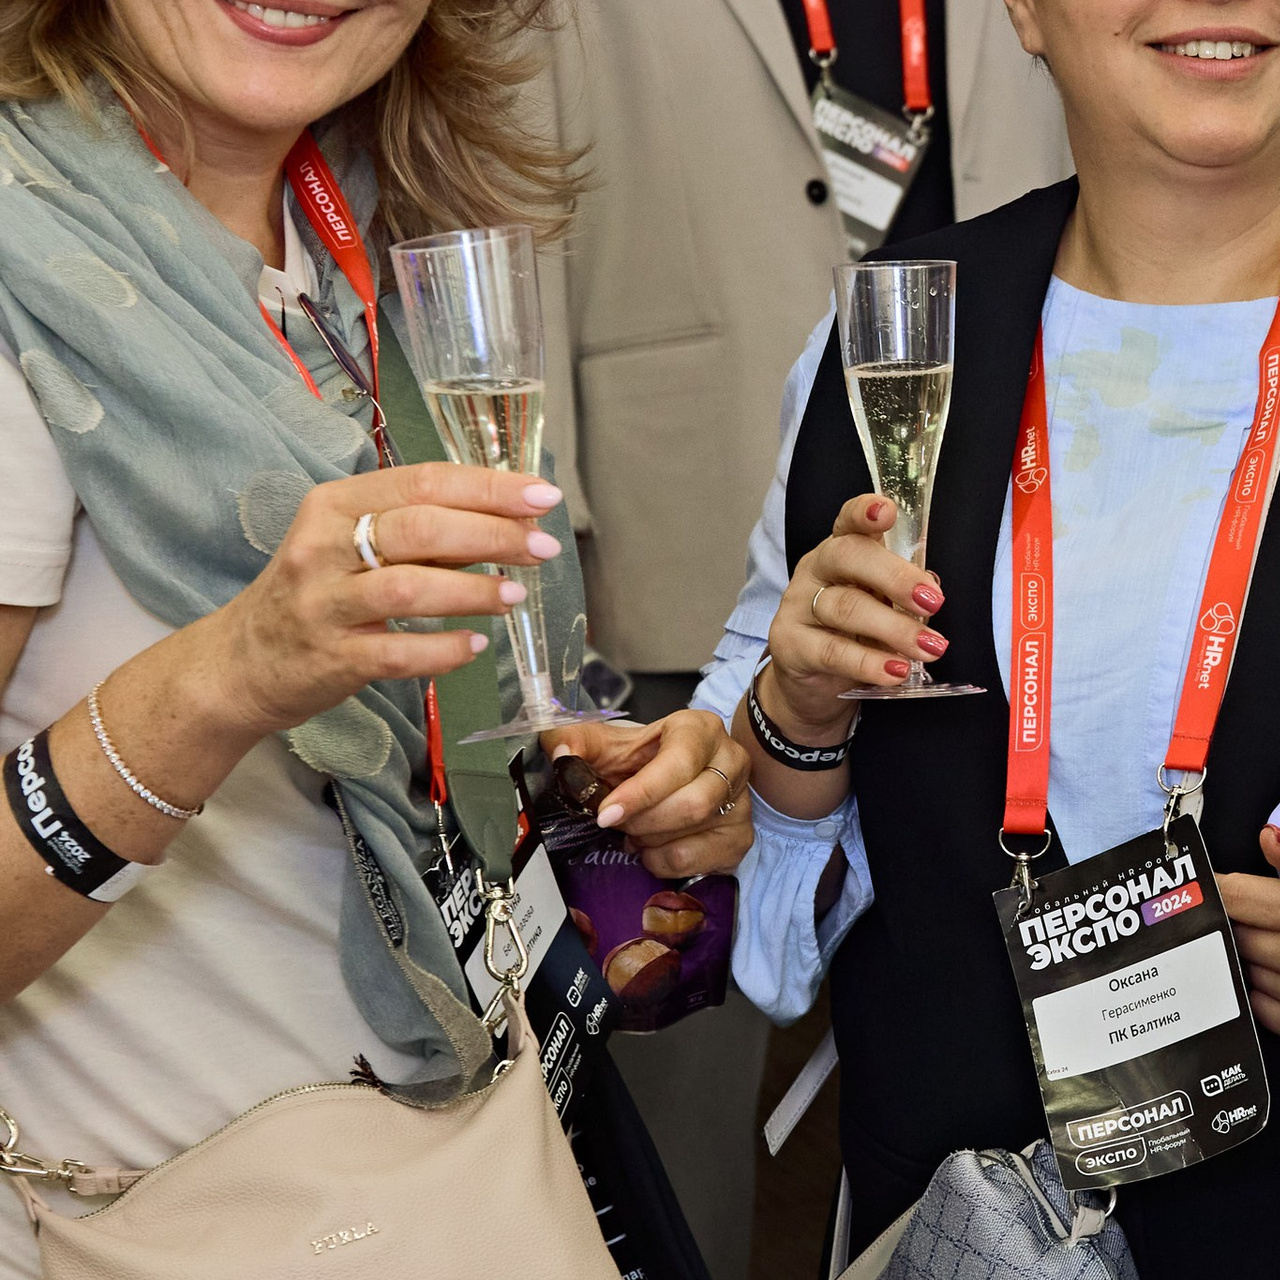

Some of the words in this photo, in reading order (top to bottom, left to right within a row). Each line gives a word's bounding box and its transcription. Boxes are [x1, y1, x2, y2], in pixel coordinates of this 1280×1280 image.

[300, 160, 352, 241] ПЕРСОНАЛ
[1255, 353, 1280, 441] ПЕРСОНАЛ
[1021, 426, 1036, 470] HRnet
[1242, 456, 1258, 496] ЭКСПО
[1235, 505, 1250, 550] Глобальный
[1027, 580, 1038, 622] ЭКСПО
[1198, 635, 1226, 689] HRnet
[1022, 641, 1039, 743] ПЕРСОНАЛ
[58, 830, 92, 863] 2024
[1018, 853, 1198, 948] ПЕРСОНАЛ
[1034, 879, 1109, 915] обальный
[1026, 908, 1141, 971] ЭКСПО
[1151, 889, 1193, 919] 2024
[1108, 966, 1160, 993] Оксана
[1101, 986, 1177, 1021] Герасименко
[1109, 1027, 1129, 1045] ПК
[1130, 1011, 1182, 1038] Балтика
[542, 1019, 570, 1081] РСОНАЛ
[1221, 1063, 1243, 1080] КАК
[1223, 1072, 1247, 1087] ДЕЛАТЬ
[553, 1080, 568, 1110] КСПО
[1077, 1097, 1185, 1142] ПЕРСОНАЛ
[1230, 1105, 1257, 1123] HRnet
[1148, 1128, 1191, 1148] Глобальный
[1149, 1138, 1188, 1155] HR-форум
[1085, 1148, 1138, 1170] ЭКСПО
[310, 1222, 380, 1256] FURLA
